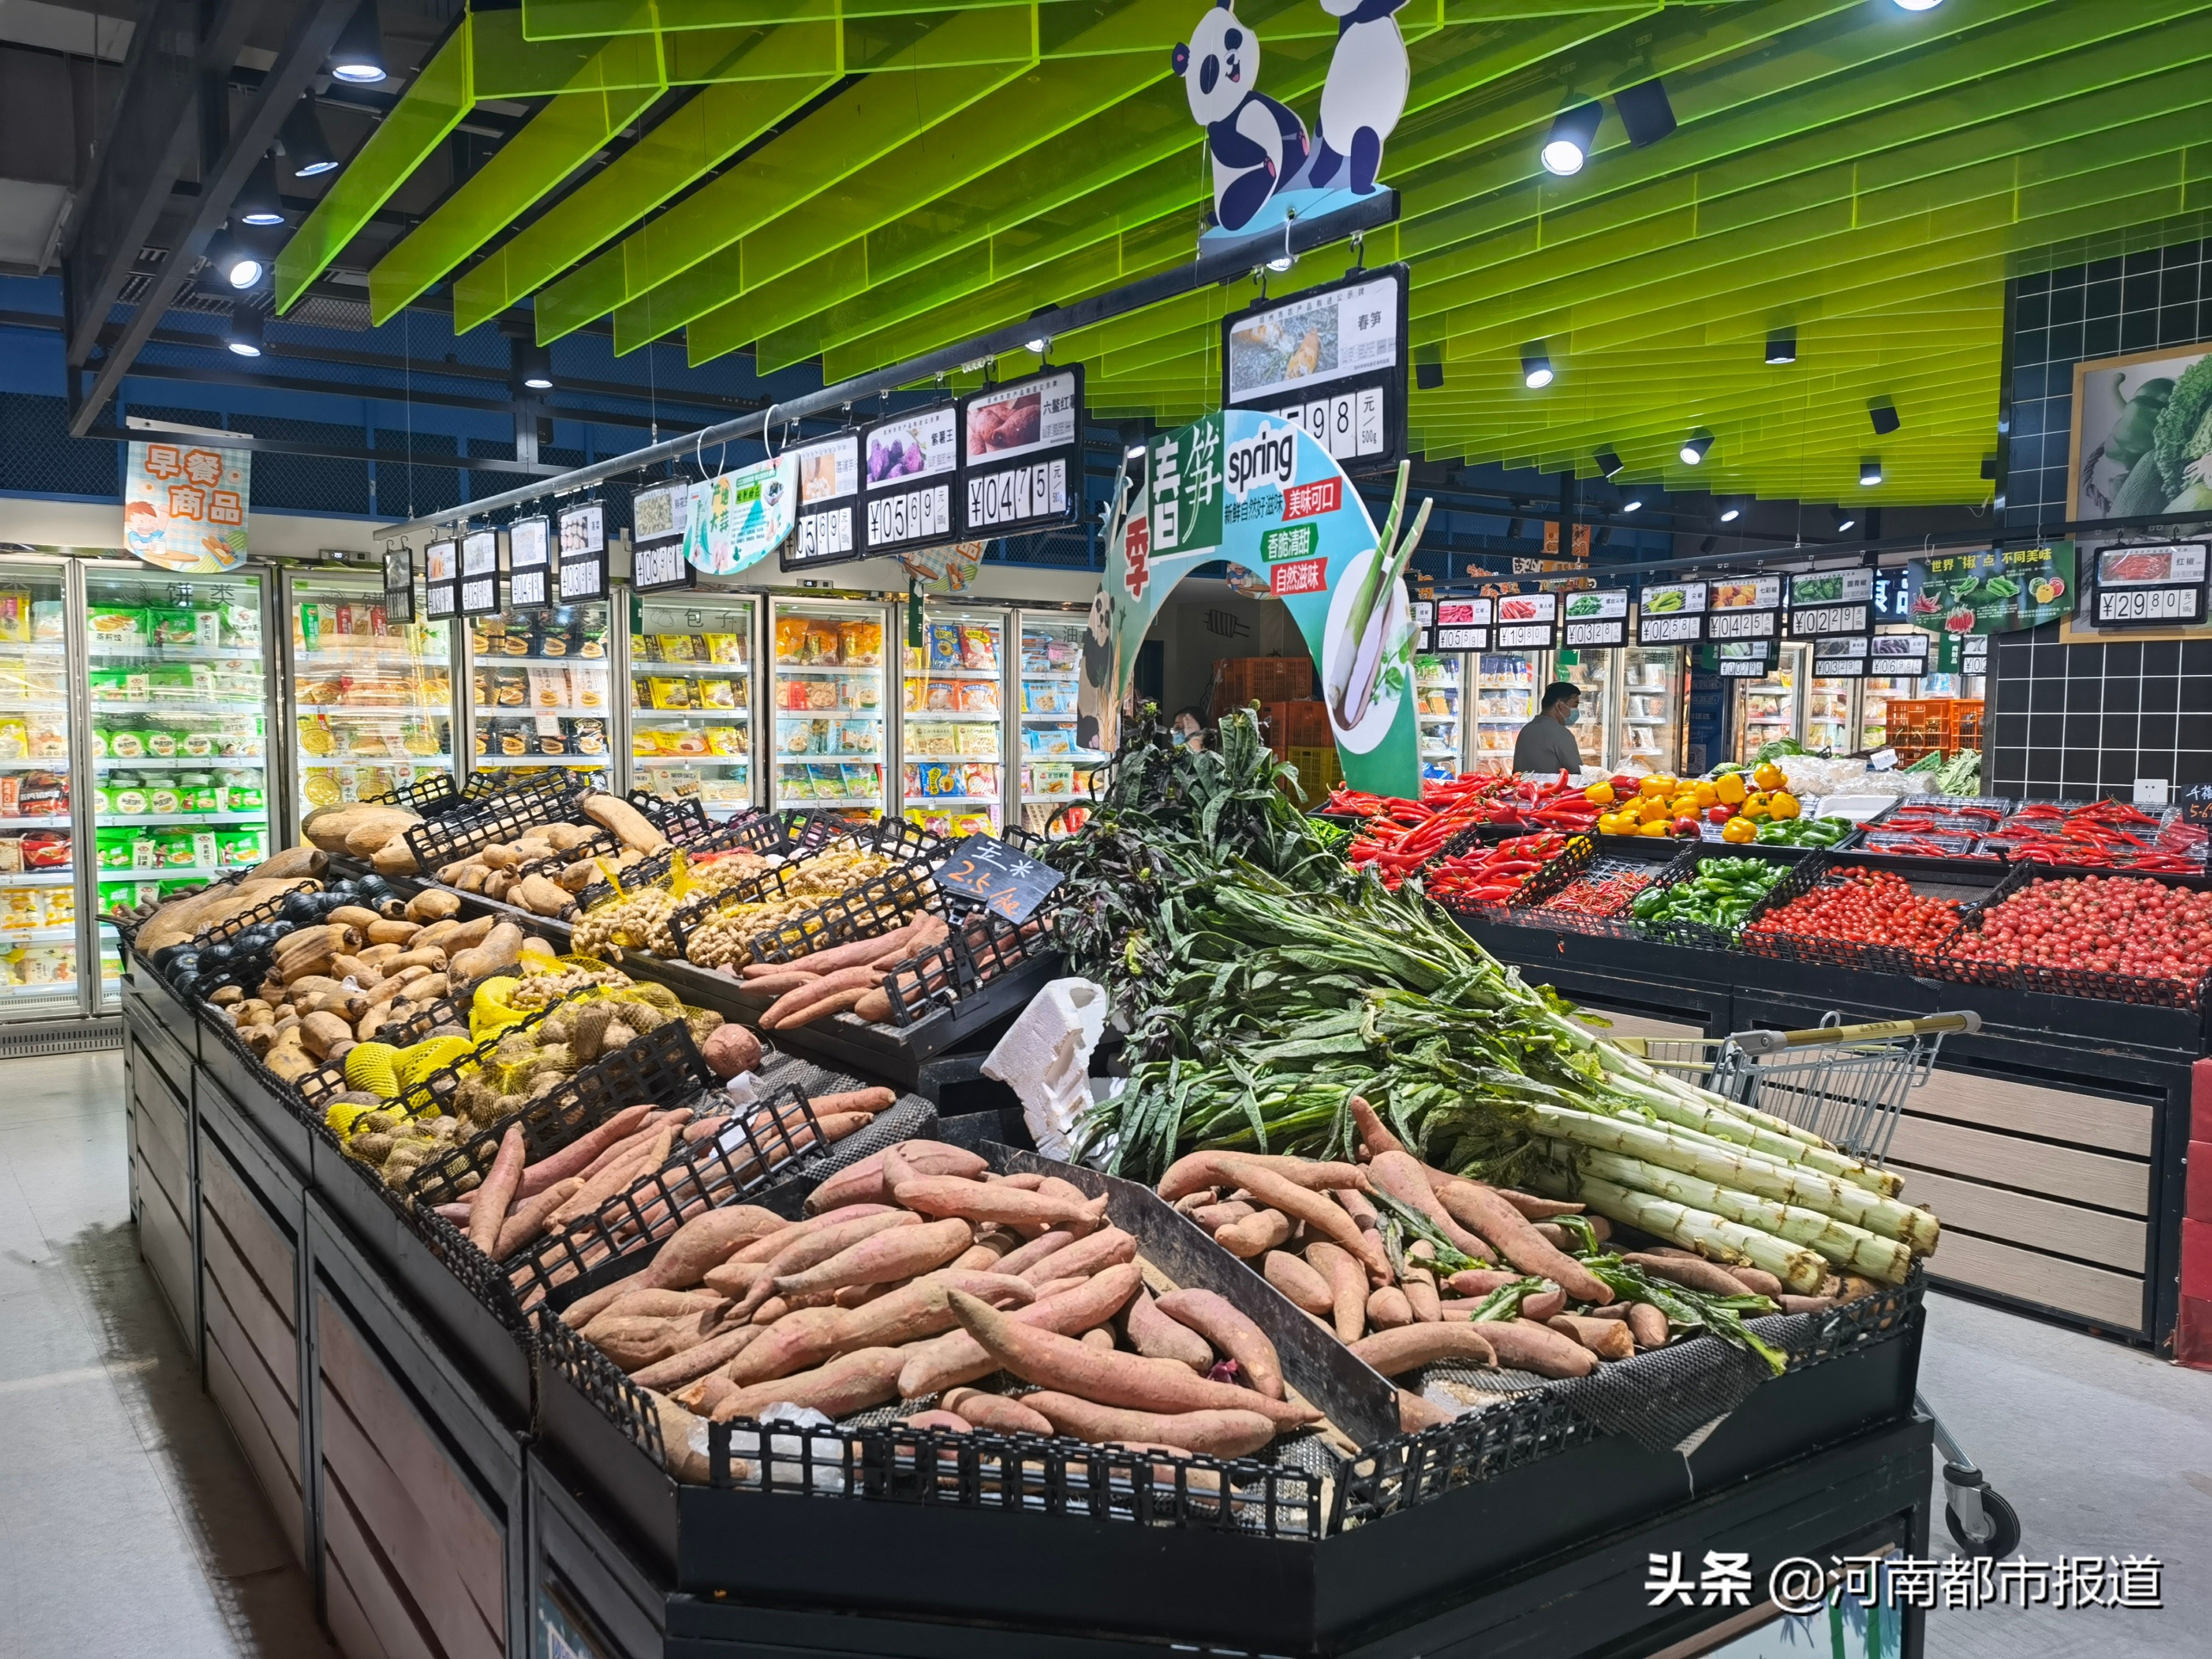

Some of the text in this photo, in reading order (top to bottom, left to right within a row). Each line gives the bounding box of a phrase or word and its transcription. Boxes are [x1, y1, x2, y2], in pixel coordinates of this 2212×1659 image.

[1358, 311, 1381, 331] 春笋
[931, 429, 953, 446] 紫薯王
[146, 446, 222, 486] 早餐
[1228, 431, 1293, 493] spring
[168, 485, 242, 525] 商品
[1224, 492, 1283, 525] 新鲜自然好滋味
[1289, 483, 1334, 518] 美味可口
[1268, 527, 1311, 559] 香脆清甜
[2001, 548, 2052, 564] 不同美味
[1276, 561, 1319, 593] 自然滋味
[2176, 557, 2195, 566] 红椒
[166, 582, 235, 607] 饼类
[684, 608, 734, 628] 包子
[1641, 650, 1675, 664] 牛羊肉卷
[971, 840, 1034, 879] 玉米
